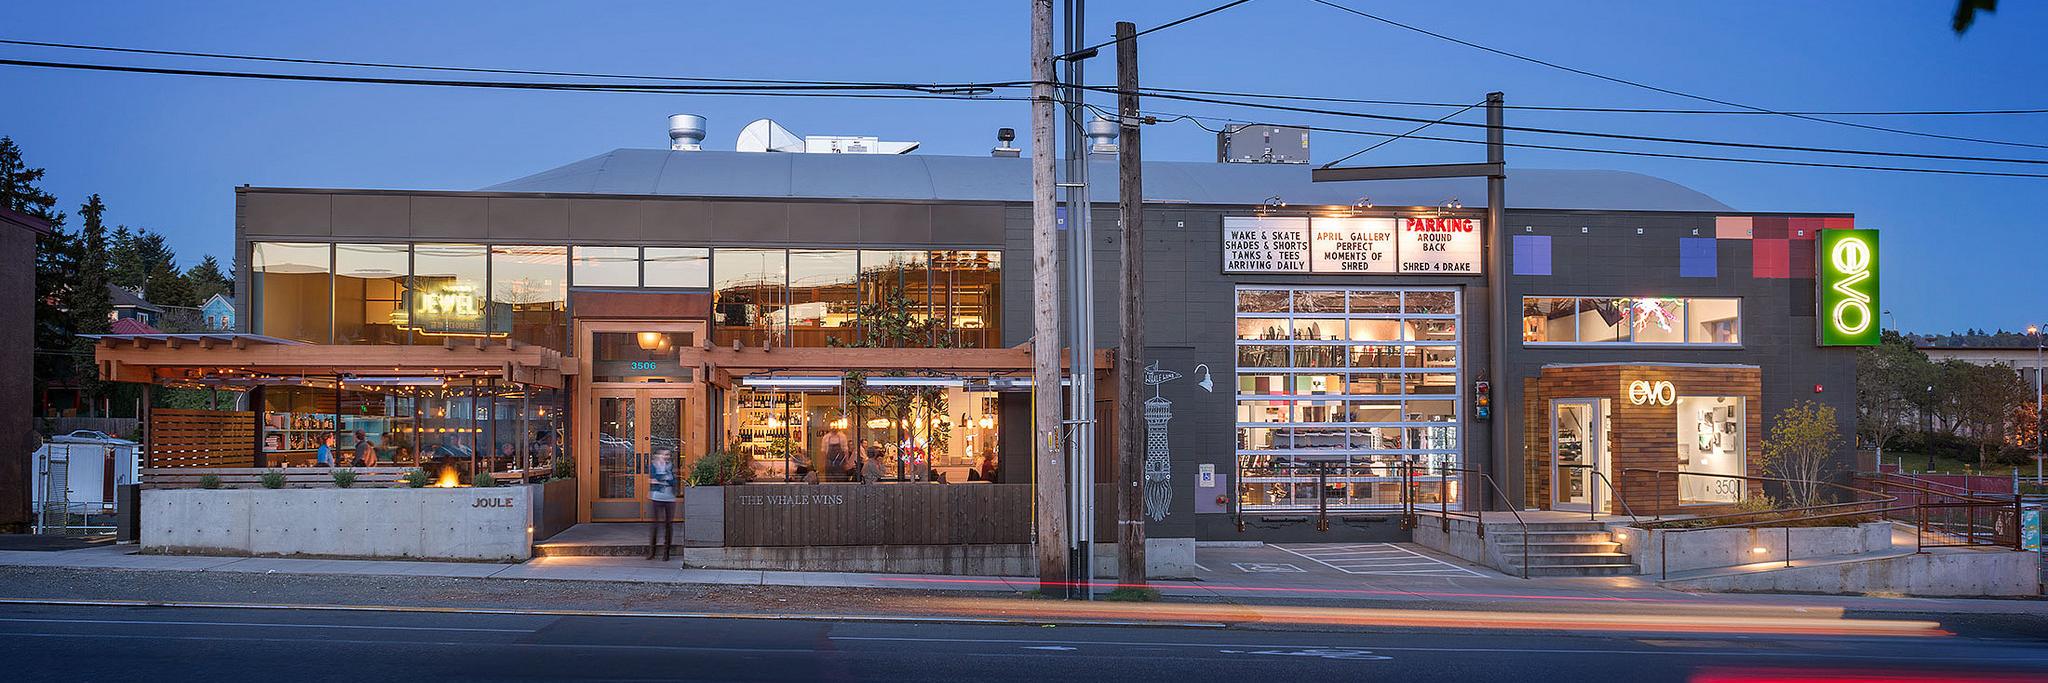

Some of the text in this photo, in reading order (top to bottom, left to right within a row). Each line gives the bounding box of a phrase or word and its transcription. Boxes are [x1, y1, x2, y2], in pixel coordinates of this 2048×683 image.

[1406, 218, 1473, 232] PARKING
[1231, 231, 1301, 240] WAKE & SKATE
[1317, 232, 1390, 241] APRIL GALLERY
[1418, 233, 1452, 242] AROUND
[1225, 241, 1308, 250] SHADES & SHORTS
[1336, 242, 1373, 251] PERFECT
[1423, 243, 1446, 251] BACK
[1232, 251, 1300, 260] TANKS & TEES
[1324, 252, 1382, 261] MOMENTS OF
[1228, 261, 1305, 270] ARRIVING DAILY
[1341, 261, 1369, 270] SHRED
[1403, 262, 1471, 271] SHRED 4 DRAKE
[1832, 237, 1870, 334] evo
[631, 361, 657, 370] 3506
[1628, 380, 1676, 406] evo
[1715, 479, 1739, 495] 350
[471, 497, 514, 508] JOULE
[740, 494, 843, 505] THE WHALE WINS
